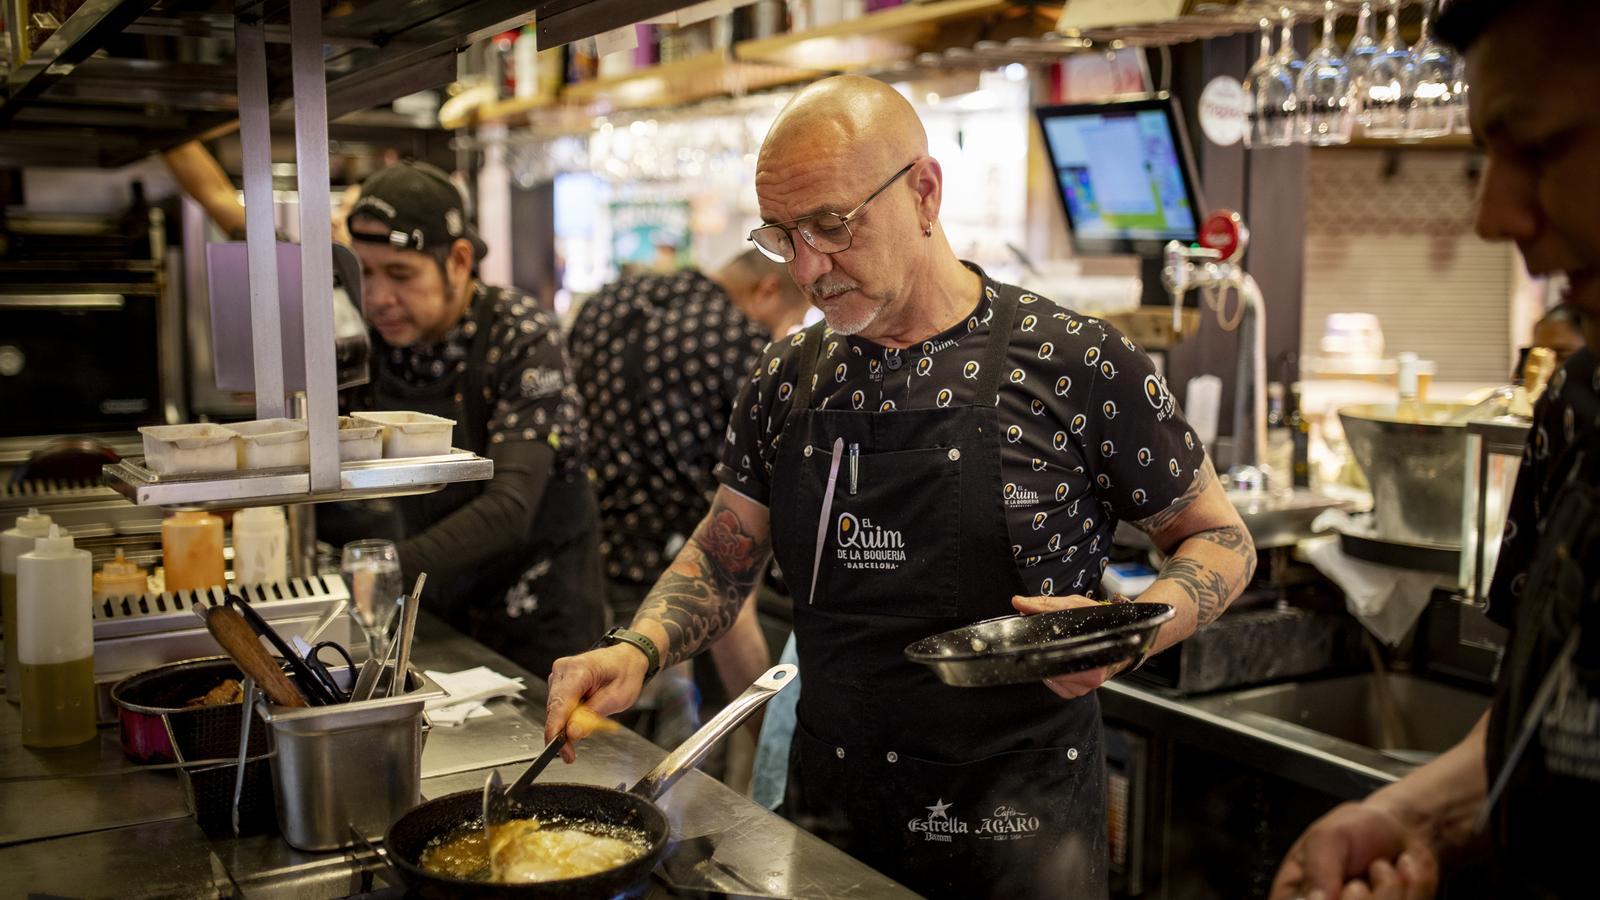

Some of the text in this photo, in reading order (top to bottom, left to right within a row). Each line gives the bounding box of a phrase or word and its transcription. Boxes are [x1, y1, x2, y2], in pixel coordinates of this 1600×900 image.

[1021, 315, 1038, 333] Q
[790, 332, 806, 347] Q
[1038, 342, 1054, 360] Q
[1084, 346, 1101, 367] Q
[767, 357, 782, 376] Q
[835, 363, 848, 383] Q
[916, 356, 932, 377] Q
[963, 360, 980, 380] Q
[1010, 368, 1026, 385] Q
[1100, 360, 1119, 380] Q
[778, 382, 794, 402] Q
[1055, 376, 1072, 398] Q
[852, 390, 866, 410] Q
[936, 388, 953, 409] Q
[1103, 400, 1121, 420] Q
[1007, 425, 1023, 444] Q
[1070, 413, 1087, 436] Q
[1053, 430, 1068, 452] Q
[1101, 440, 1118, 458] Q
[1137, 447, 1155, 467] Q
[1168, 458, 1182, 477] Q
[1003, 482, 1039, 500] Quim
[1055, 482, 1070, 502] Q
[1132, 488, 1149, 506] Q
[837, 511, 905, 549] Quim
[862, 518, 873, 528] EL
[1032, 511, 1048, 531] Q
[1047, 533, 1061, 552] Q
[837, 549, 906, 561] DE LA BOQUERIA
[1040, 577, 1055, 597] Q
[907, 817, 969, 834] Estrella
[974, 816, 1040, 834] AGARO
[925, 831, 953, 843] Damm
